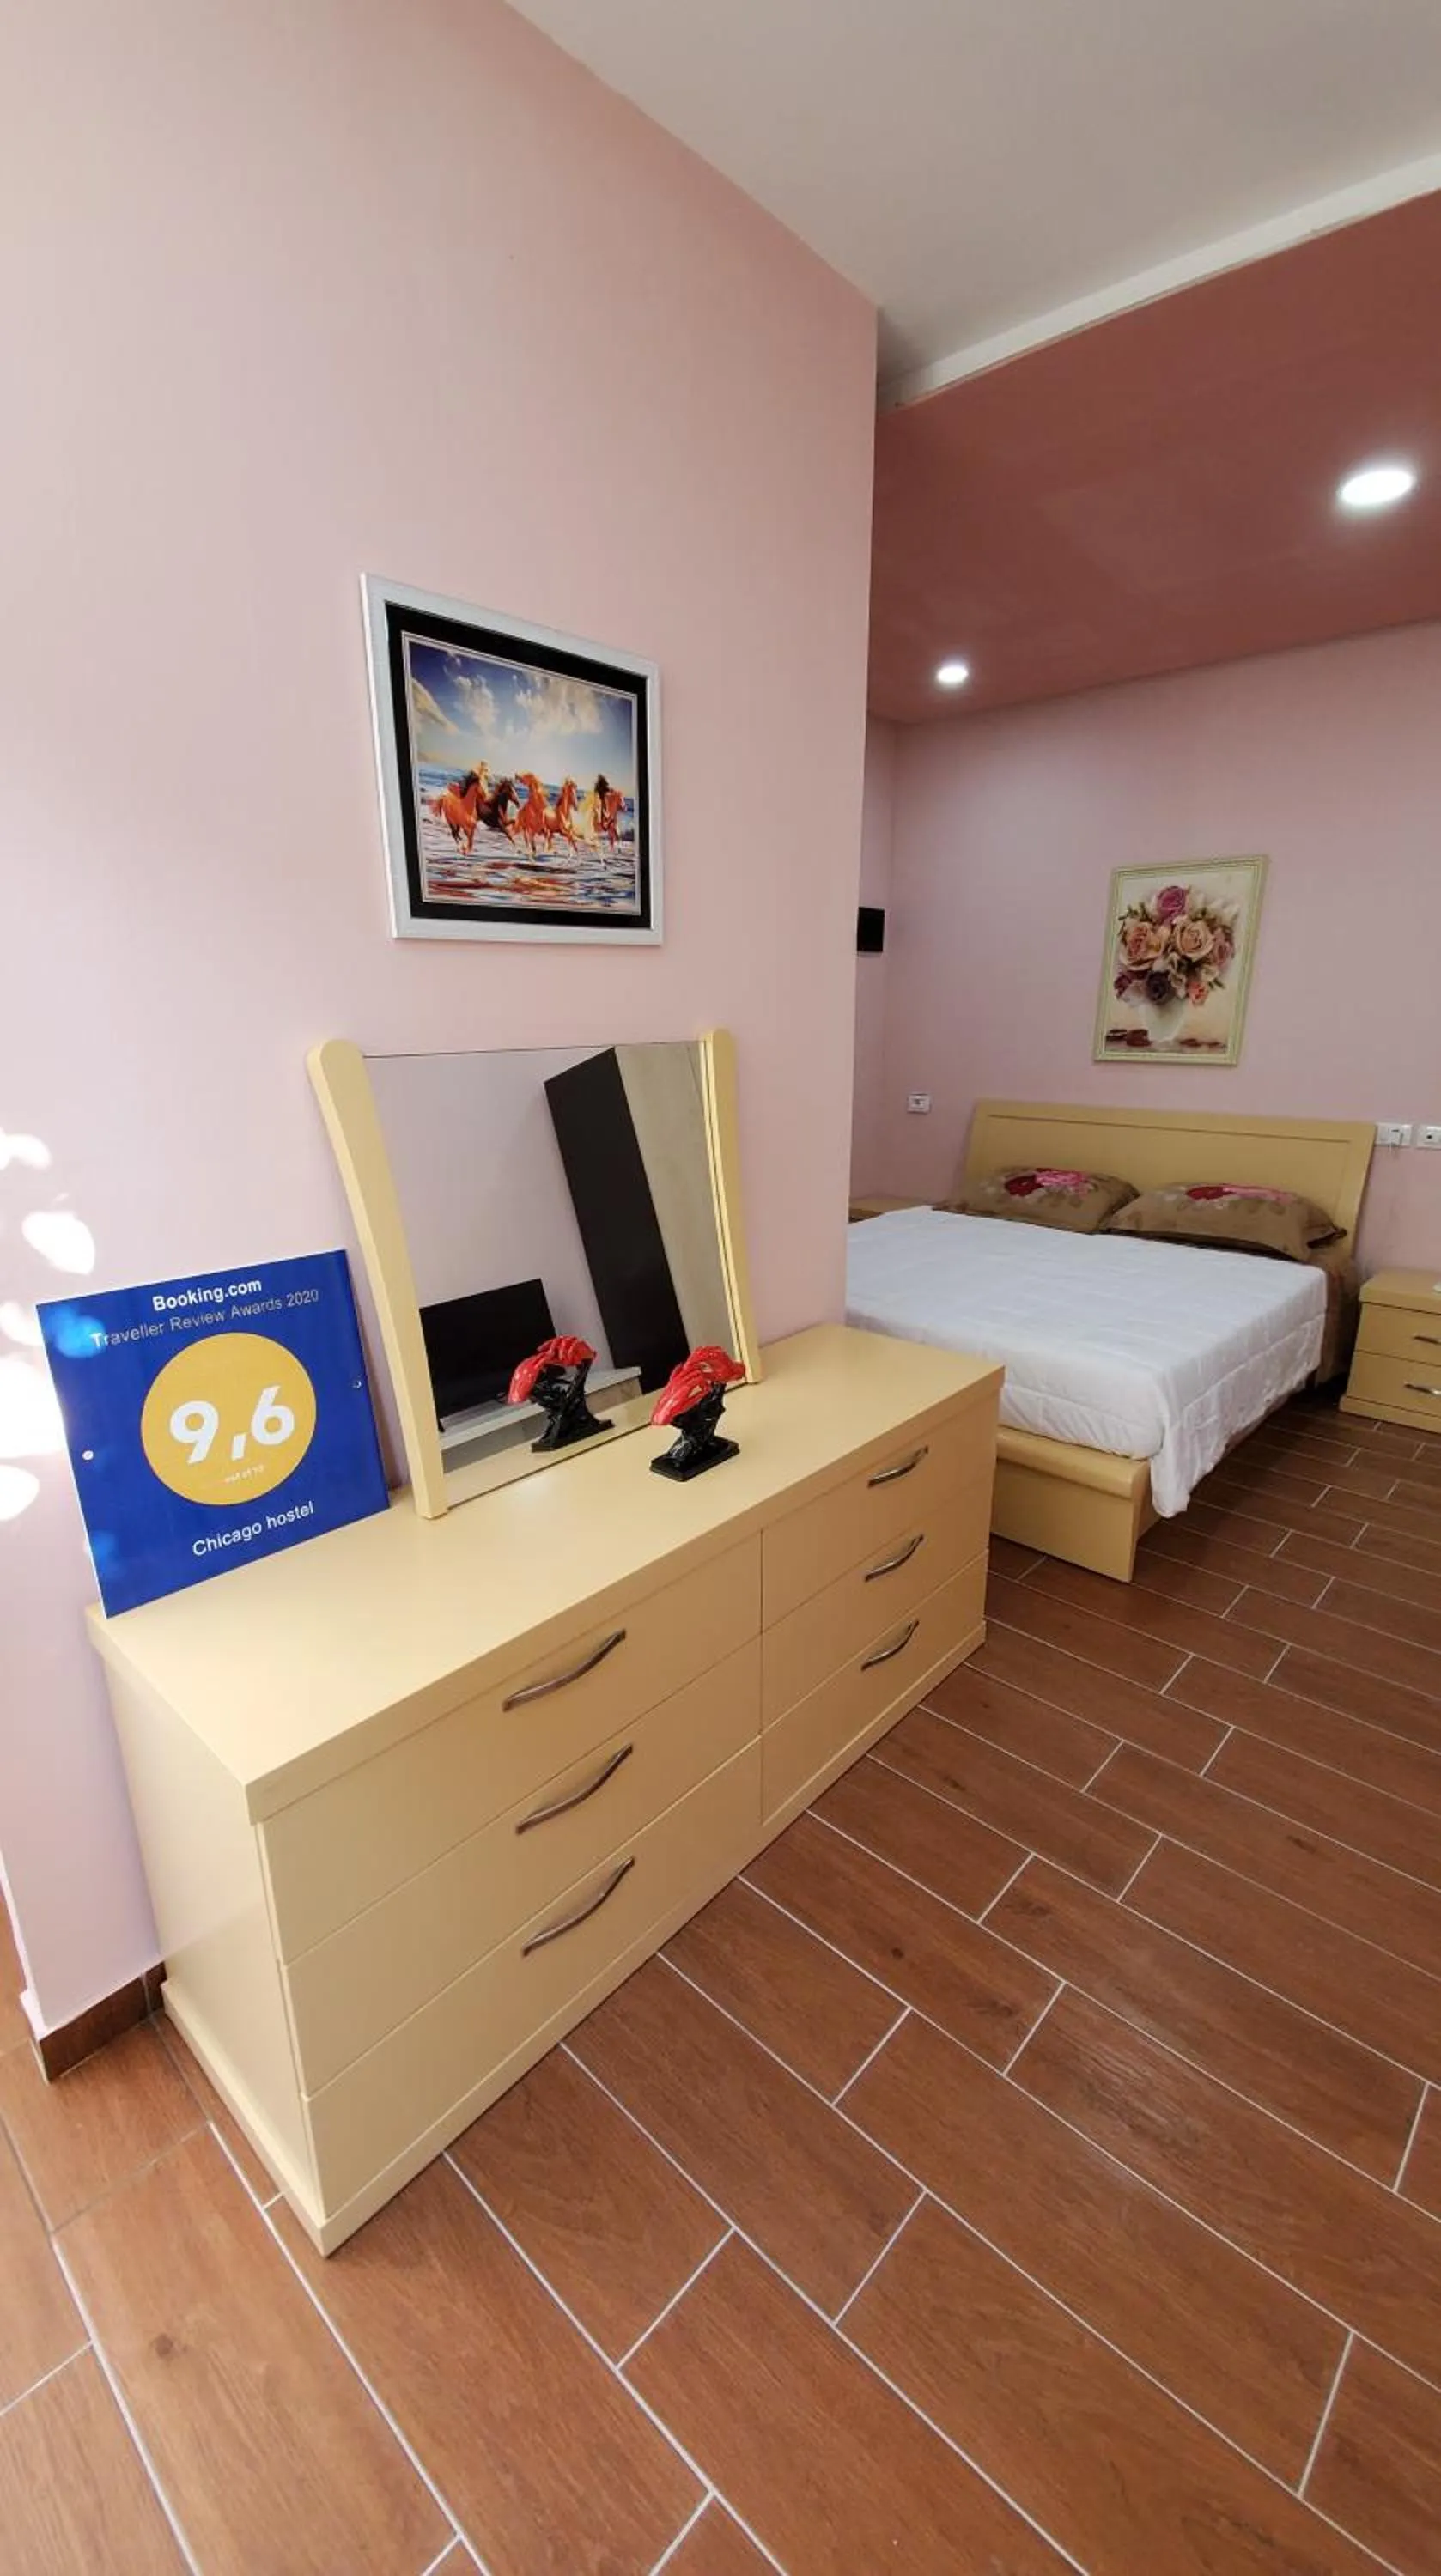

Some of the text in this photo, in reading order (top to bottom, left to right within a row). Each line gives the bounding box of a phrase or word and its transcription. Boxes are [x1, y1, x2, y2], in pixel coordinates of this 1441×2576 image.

[89, 1289, 319, 1348] Traveller Review Awards 2020
[152, 1279, 262, 1311] Booking.com
[169, 1385, 295, 1465] 9,6
[192, 1501, 314, 1556] Chicago hostel
